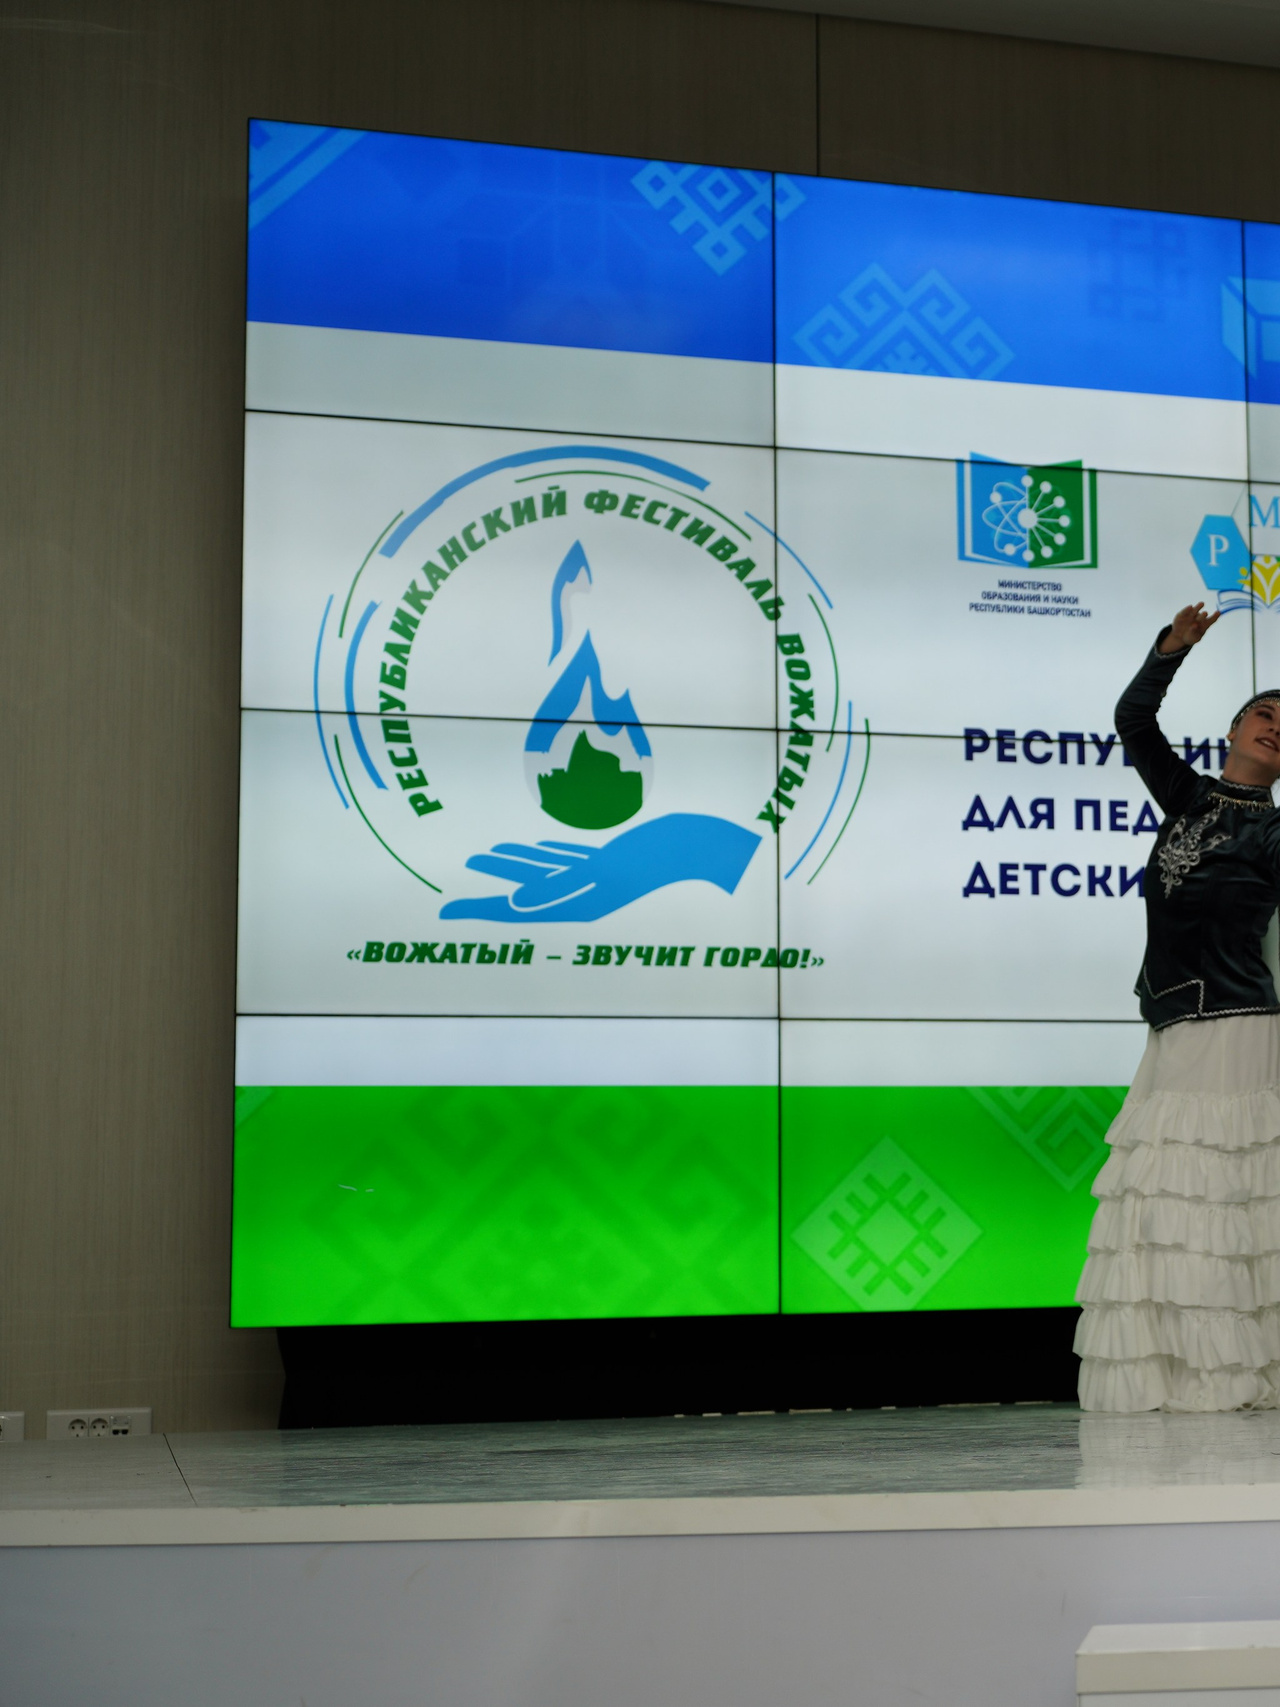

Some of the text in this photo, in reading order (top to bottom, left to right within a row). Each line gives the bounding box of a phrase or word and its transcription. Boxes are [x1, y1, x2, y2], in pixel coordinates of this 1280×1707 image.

[981, 591, 1079, 605] ОБРАЗОВАНИЯ И НАУКИ
[998, 579, 1062, 591] МИНИСТЕРСТВО
[969, 602, 1091, 617] РЕСПУБЛИКИ БАШКОРТОСТАН
[379, 486, 814, 833] РЕСПУБЛИКАНСКИЙ ФЕСТИВАЛЬ ВОЖАТЫХ
[962, 794, 1055, 831] ДЛЯ
[963, 861, 1146, 898] ДЕТСКИ
[346, 939, 535, 966] «ВОЖАТЫЙ
[573, 944, 695, 967] ЗВУЧИТ
